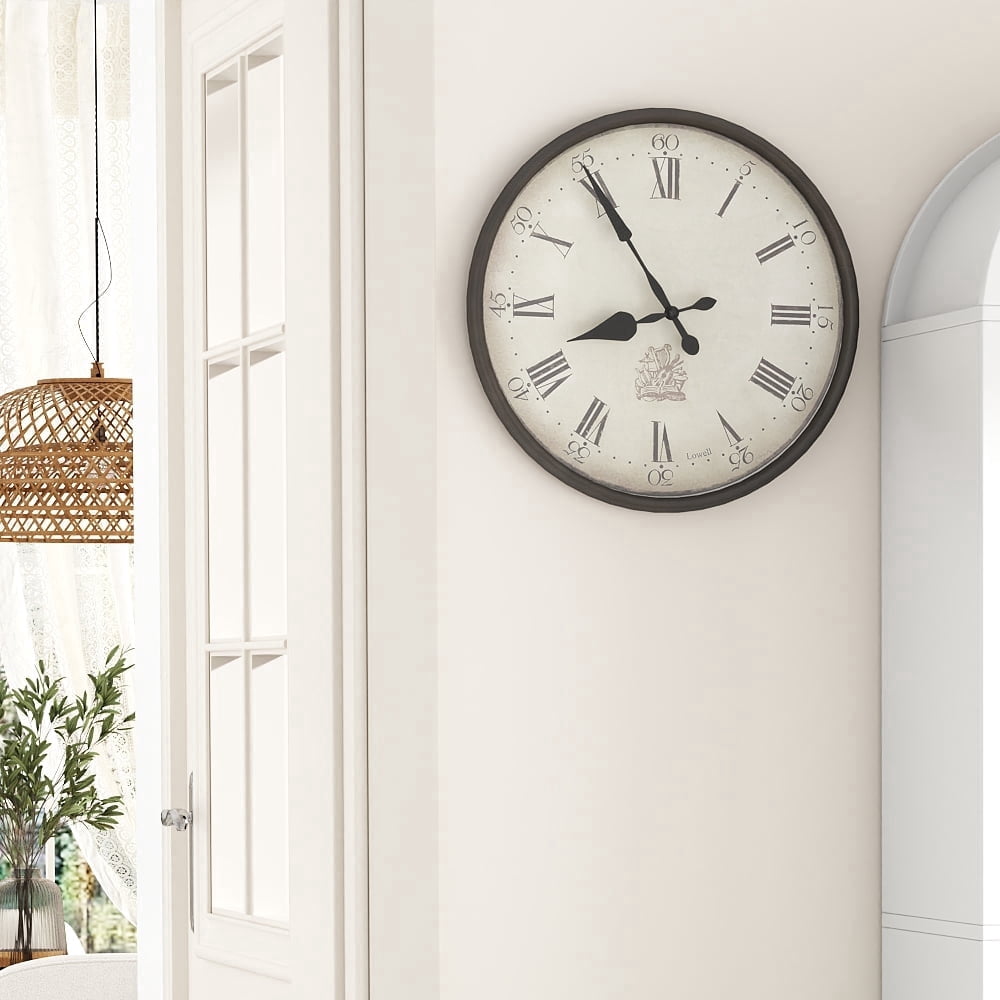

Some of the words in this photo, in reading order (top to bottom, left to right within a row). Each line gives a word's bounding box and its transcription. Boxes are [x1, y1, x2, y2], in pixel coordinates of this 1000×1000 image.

[652, 133, 680, 151] 60
[571, 148, 594, 174] 55
[739, 160, 756, 176] 5
[648, 156, 681, 200] XII
[510, 206, 532, 236] 50
[793, 220, 816, 246] 10
[529, 221, 575, 259] X
[755, 233, 796, 266] II
[489, 290, 507, 318] 45
[513, 292, 555, 320] IX
[770, 304, 811, 328] III
[817, 305, 834, 330] 15
[526, 348, 573, 400] VIII
[508, 376, 530, 401] 40
[790, 383, 814, 412] 20
[574, 395, 611, 447] VII
[715, 408, 744, 448] V
[563, 440, 591, 464] 35
[651, 420, 675, 463] VI
[686, 448, 713, 460] Lowell
[728, 445, 754, 472] 25
[647, 468, 674, 487] 30
